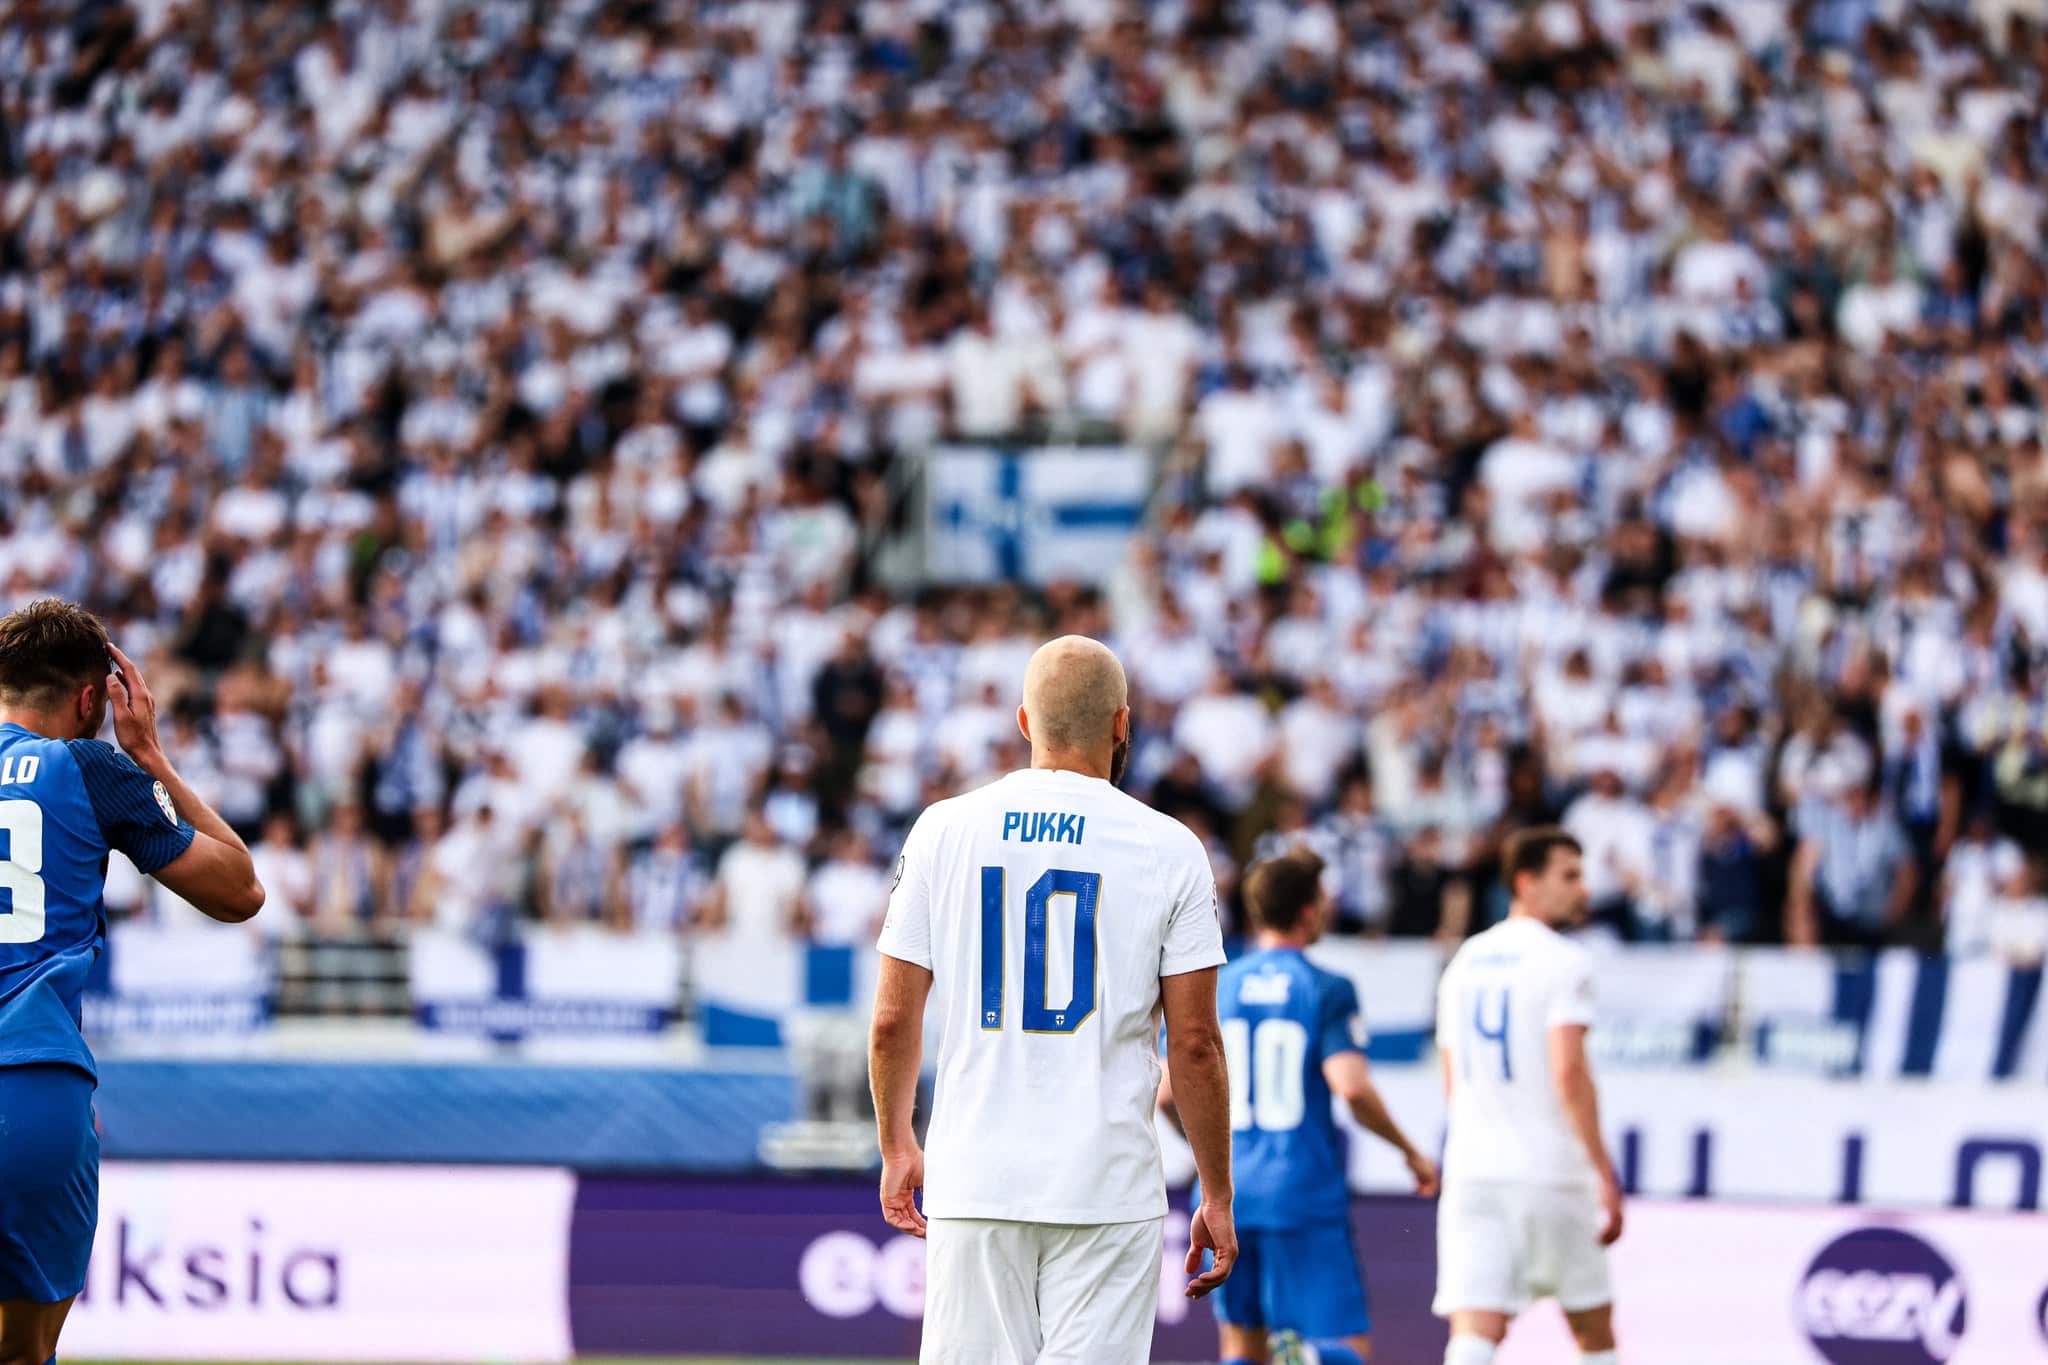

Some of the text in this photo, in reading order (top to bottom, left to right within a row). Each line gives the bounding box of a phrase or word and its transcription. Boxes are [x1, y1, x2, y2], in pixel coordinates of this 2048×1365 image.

[1003, 812, 1085, 845] PUKKI
[981, 867, 1102, 1035] 10
[1222, 1018, 1307, 1131] 10
[1473, 985, 1513, 1081] 4
[78, 1217, 340, 1306] ksia
